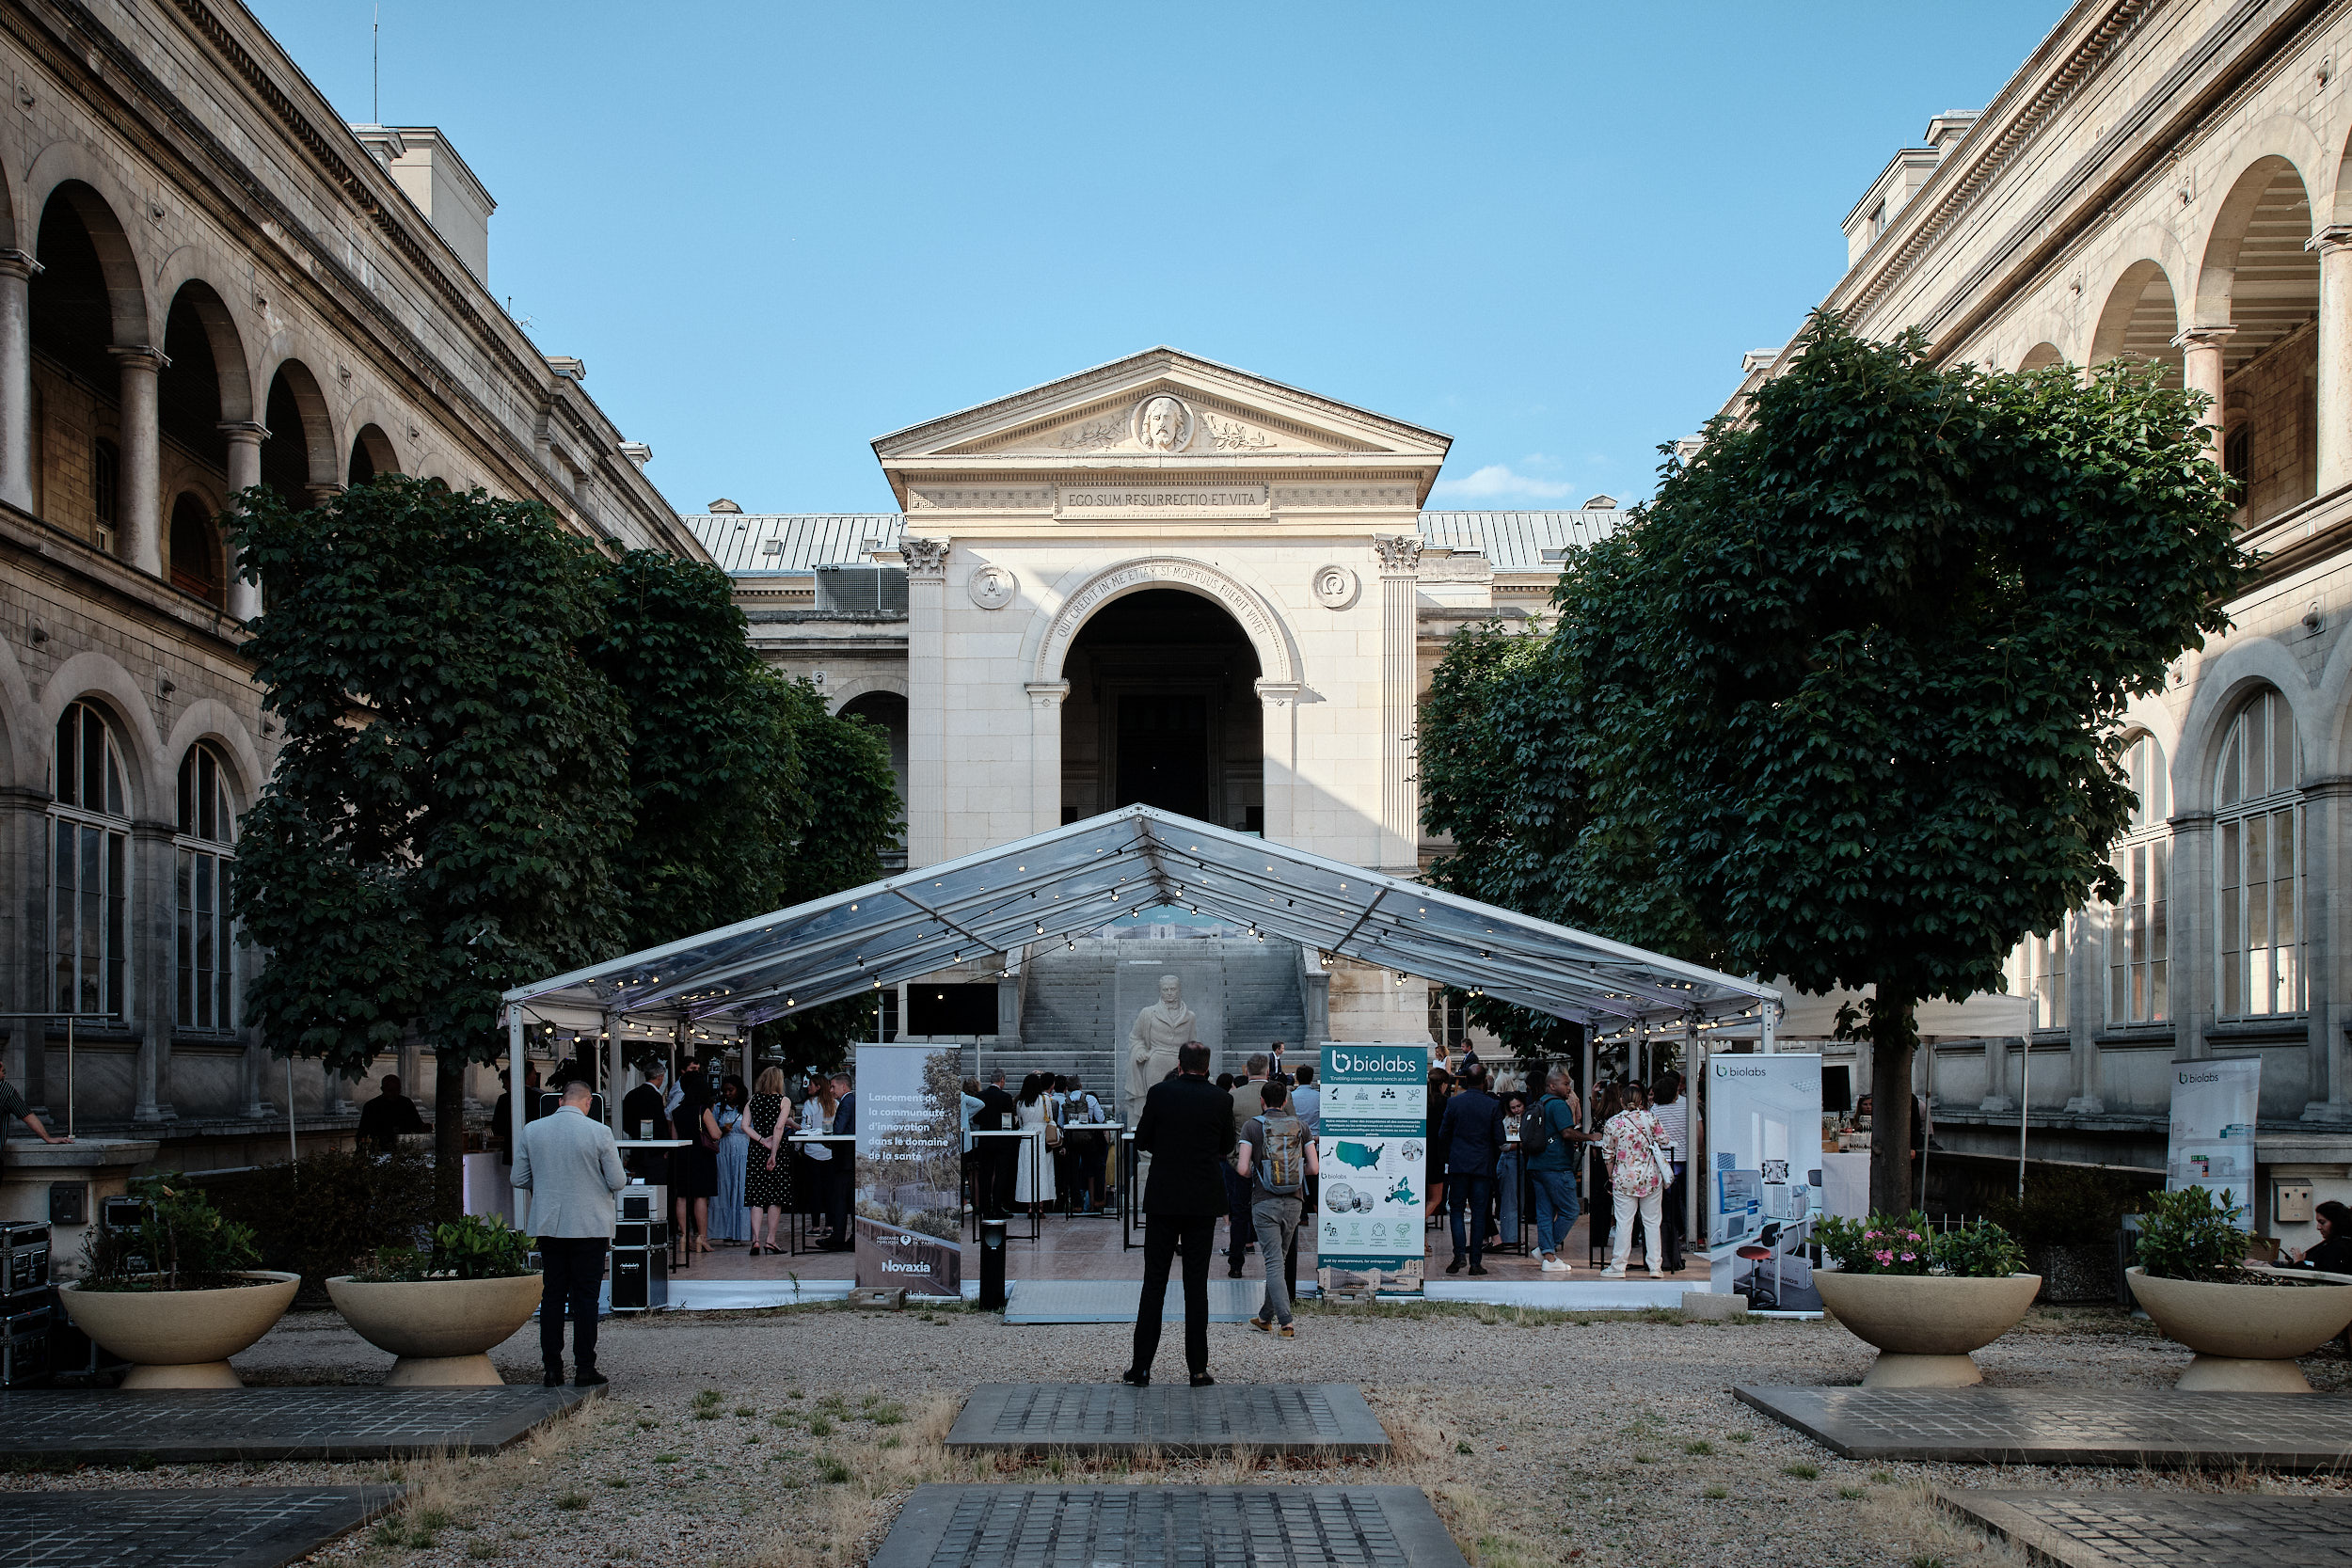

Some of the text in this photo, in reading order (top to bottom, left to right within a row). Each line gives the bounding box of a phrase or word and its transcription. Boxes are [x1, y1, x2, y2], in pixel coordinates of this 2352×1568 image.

[1069, 493, 1256, 506] EGO SUM RESURRECTIO ET VITA
[1057, 566, 1267, 638] QUI CREDIT IN ME ETIAM SI MORTUUS FUERIT VIVET
[1353, 1053, 1417, 1072] biolabs
[1729, 1066, 1767, 1077] biolabs
[2189, 1072, 2219, 1084] biolabs
[868, 1092, 937, 1102] Lancement de
[868, 1107, 946, 1117] la communauté
[868, 1122, 930, 1132] d'innovation
[868, 1136, 949, 1147] dans le domaine
[868, 1150, 922, 1161] de la santé
[882, 1259, 931, 1274] Novaxia
